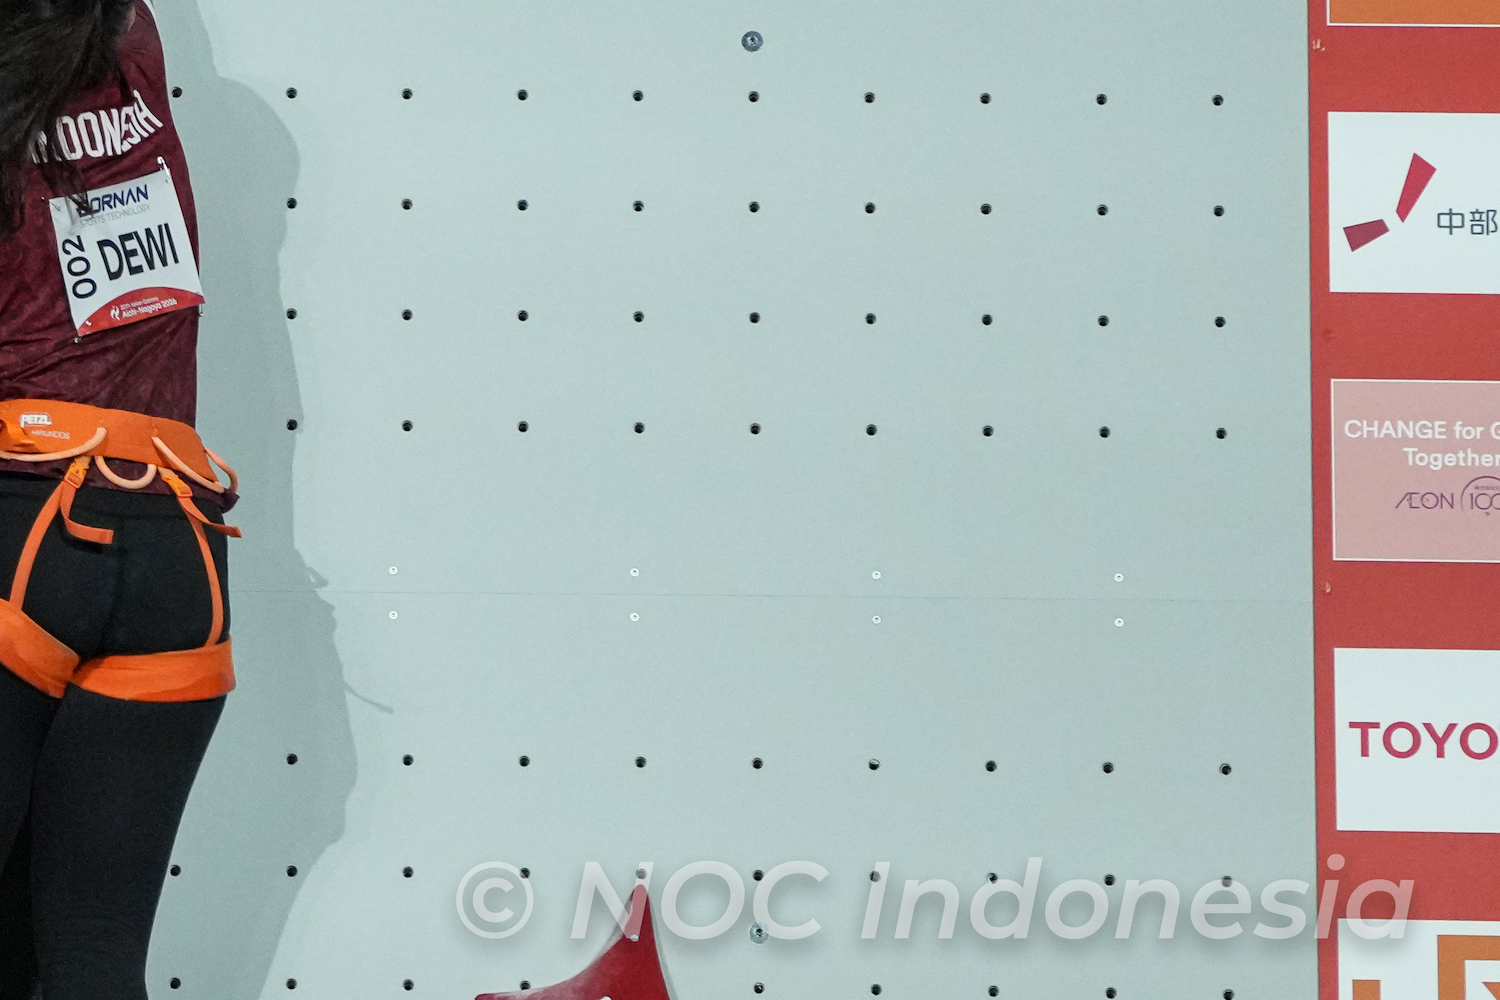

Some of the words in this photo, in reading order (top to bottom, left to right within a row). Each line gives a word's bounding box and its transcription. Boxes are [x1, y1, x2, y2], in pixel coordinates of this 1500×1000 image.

[106, 204, 150, 222] TECHNOLOGY
[96, 222, 179, 281] DEWI
[62, 235, 97, 299] 002
[161, 298, 178, 308] 2026
[20, 414, 52, 428] PETZL
[1344, 419, 1447, 439] CHANGE
[1454, 421, 1484, 440] for
